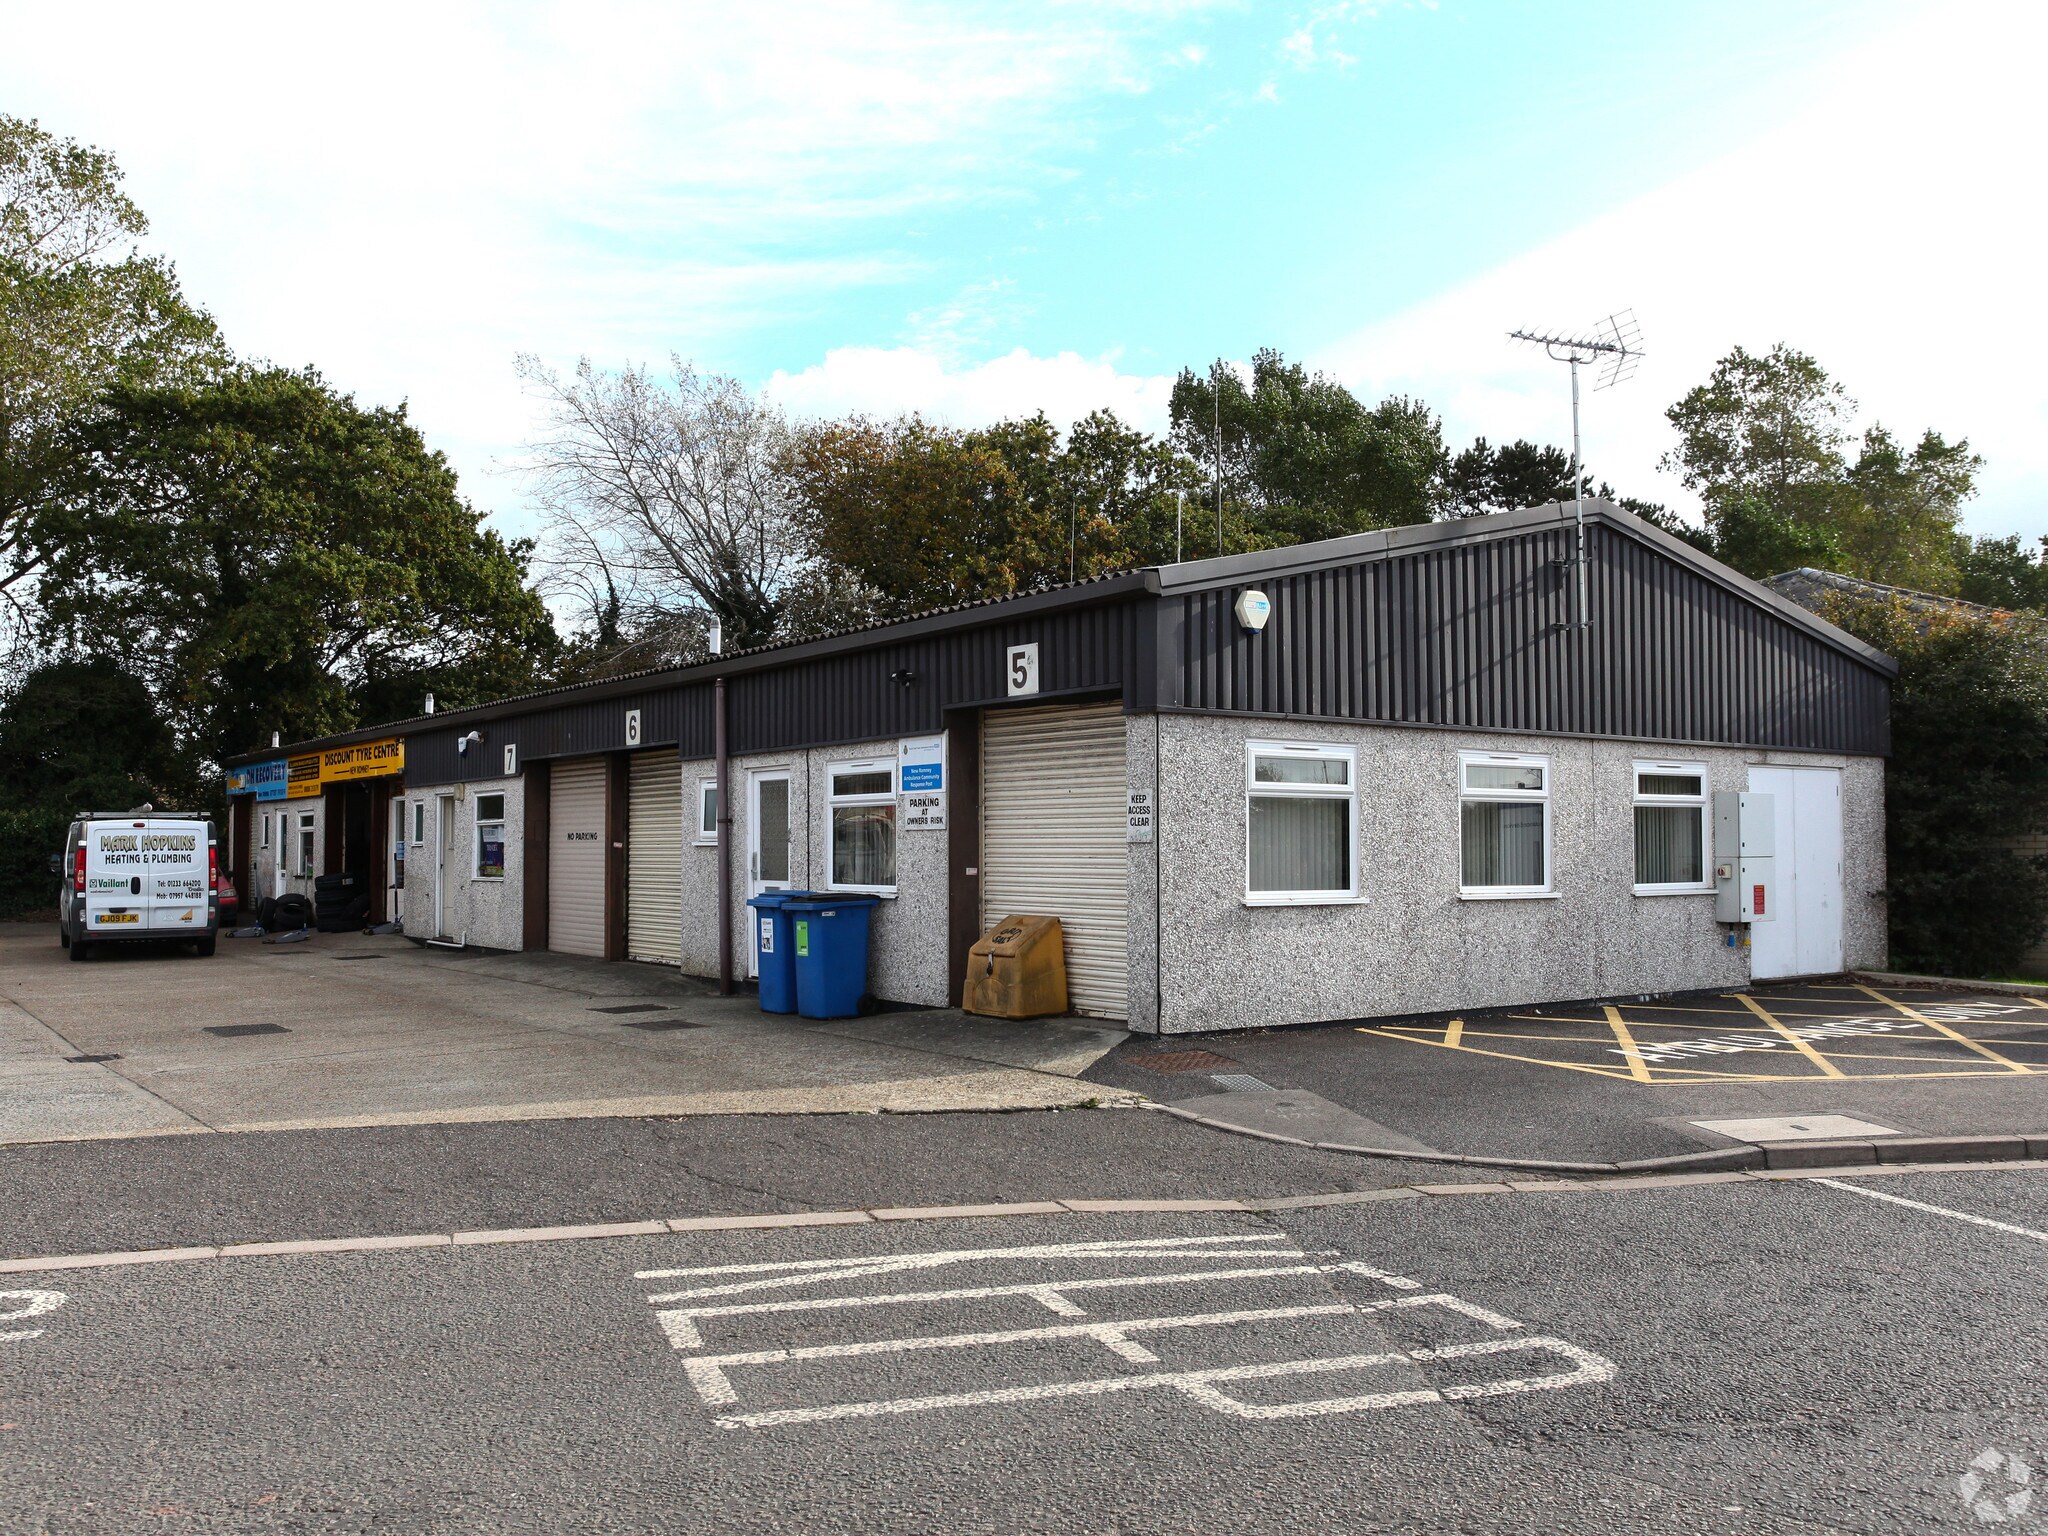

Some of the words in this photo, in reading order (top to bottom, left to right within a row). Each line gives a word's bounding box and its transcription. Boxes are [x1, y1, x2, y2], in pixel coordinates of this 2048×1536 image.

[1012, 651, 1027, 689] 5
[629, 715, 637, 740] 6
[325, 750, 354, 766] DISCOUNT
[356, 747, 372, 761] TYRE
[374, 743, 399, 759] CENTRE
[507, 748, 513, 771] 7
[256, 763, 286, 784] RECOVERY
[909, 798, 939, 807] PARKING
[1131, 794, 1147, 803] KEEP
[1128, 806, 1151, 814] ACCESS
[907, 817, 928, 825] OWNERS
[930, 816, 943, 824] RISK
[1130, 817, 1150, 826] CLEAR
[567, 832, 575, 840] NO
[575, 832, 598, 840] PARKING
[101, 836, 138, 853] MARK
[141, 835, 196, 852] HOPKINS
[105, 854, 140, 865] HEATING
[143, 854, 149, 863] &
[152, 854, 192, 863] PLUMBING
[98, 879, 128, 888] Vaillant
[100, 915, 121, 923] GJ09
[121, 914, 138, 922] FJK
